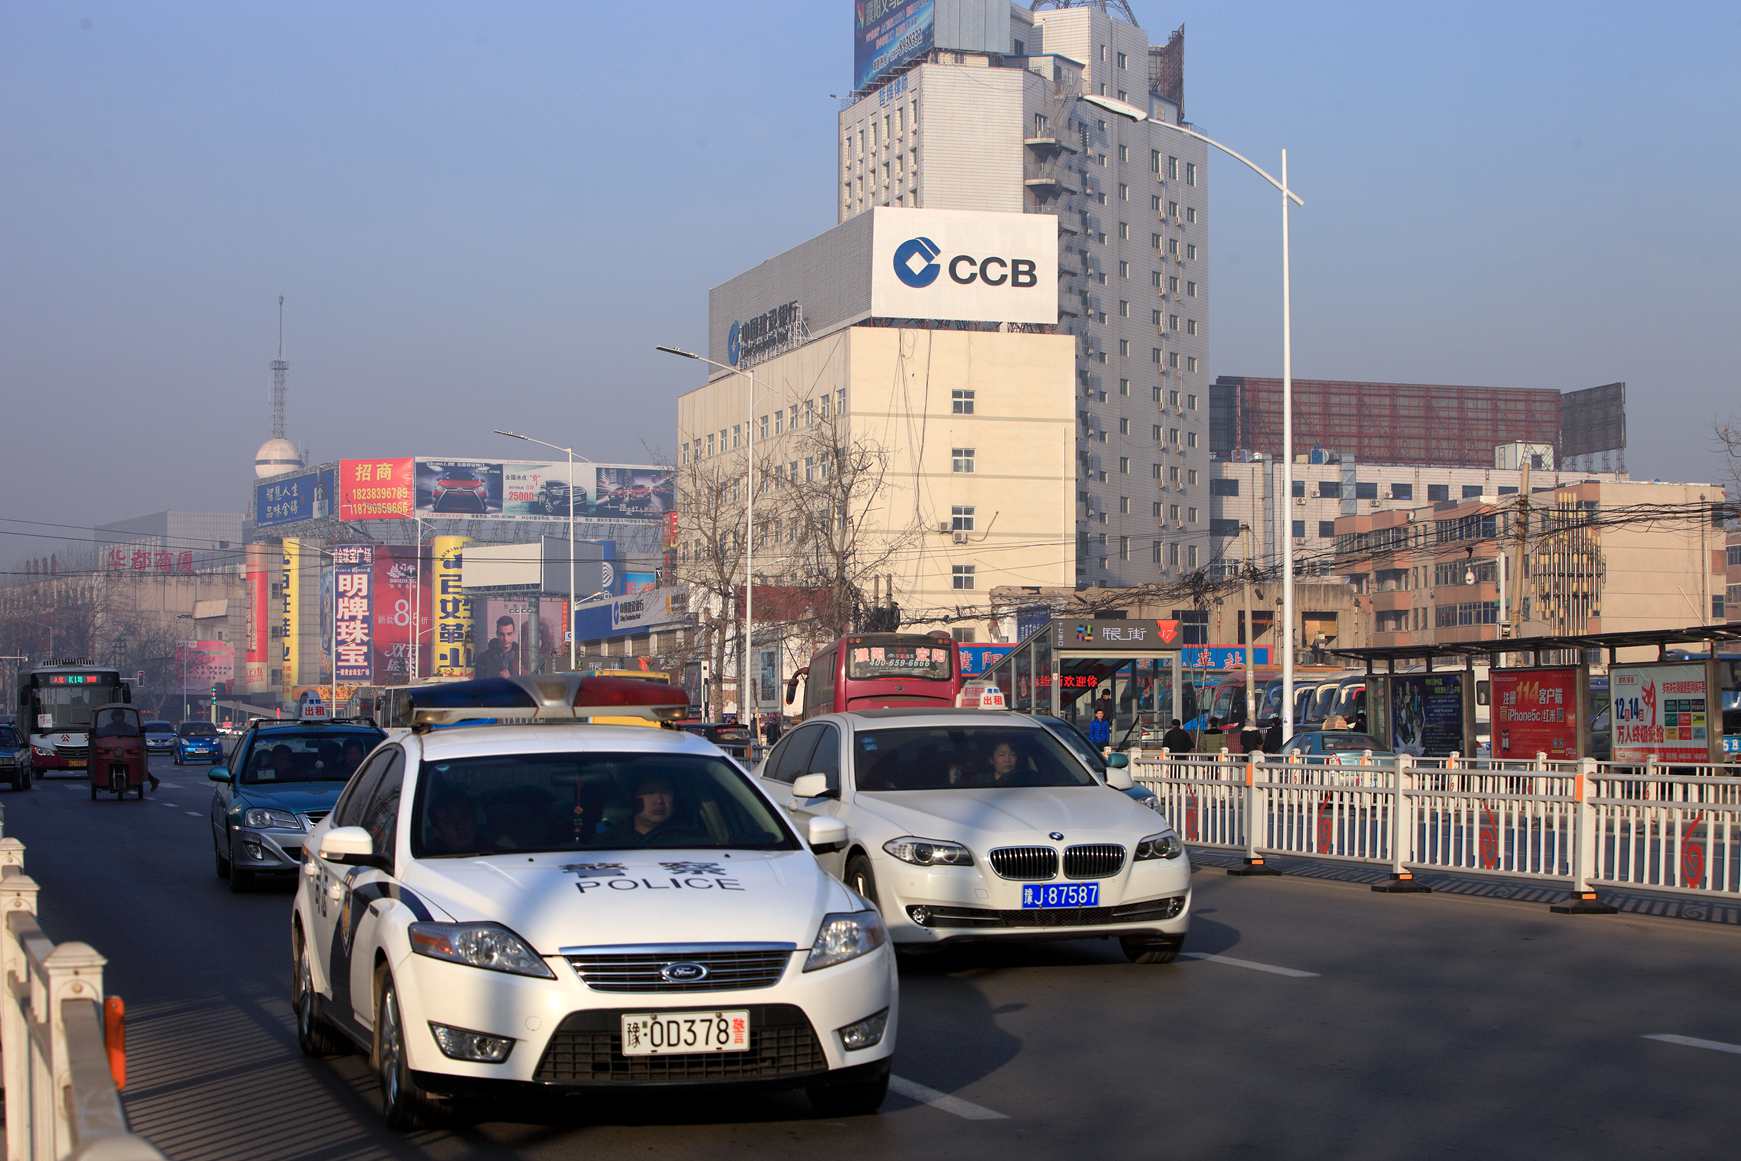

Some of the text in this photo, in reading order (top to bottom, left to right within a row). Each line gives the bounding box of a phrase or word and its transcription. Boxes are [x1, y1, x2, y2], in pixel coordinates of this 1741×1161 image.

[949, 255, 1038, 288] CCB
[355, 463, 394, 481] 招商
[337, 574, 369, 666] 明牌珠宝
[984, 695, 1003, 705] 出租
[304, 706, 325, 716] 出租
[559, 861, 728, 879] 警察
[575, 868, 747, 894] POLICE
